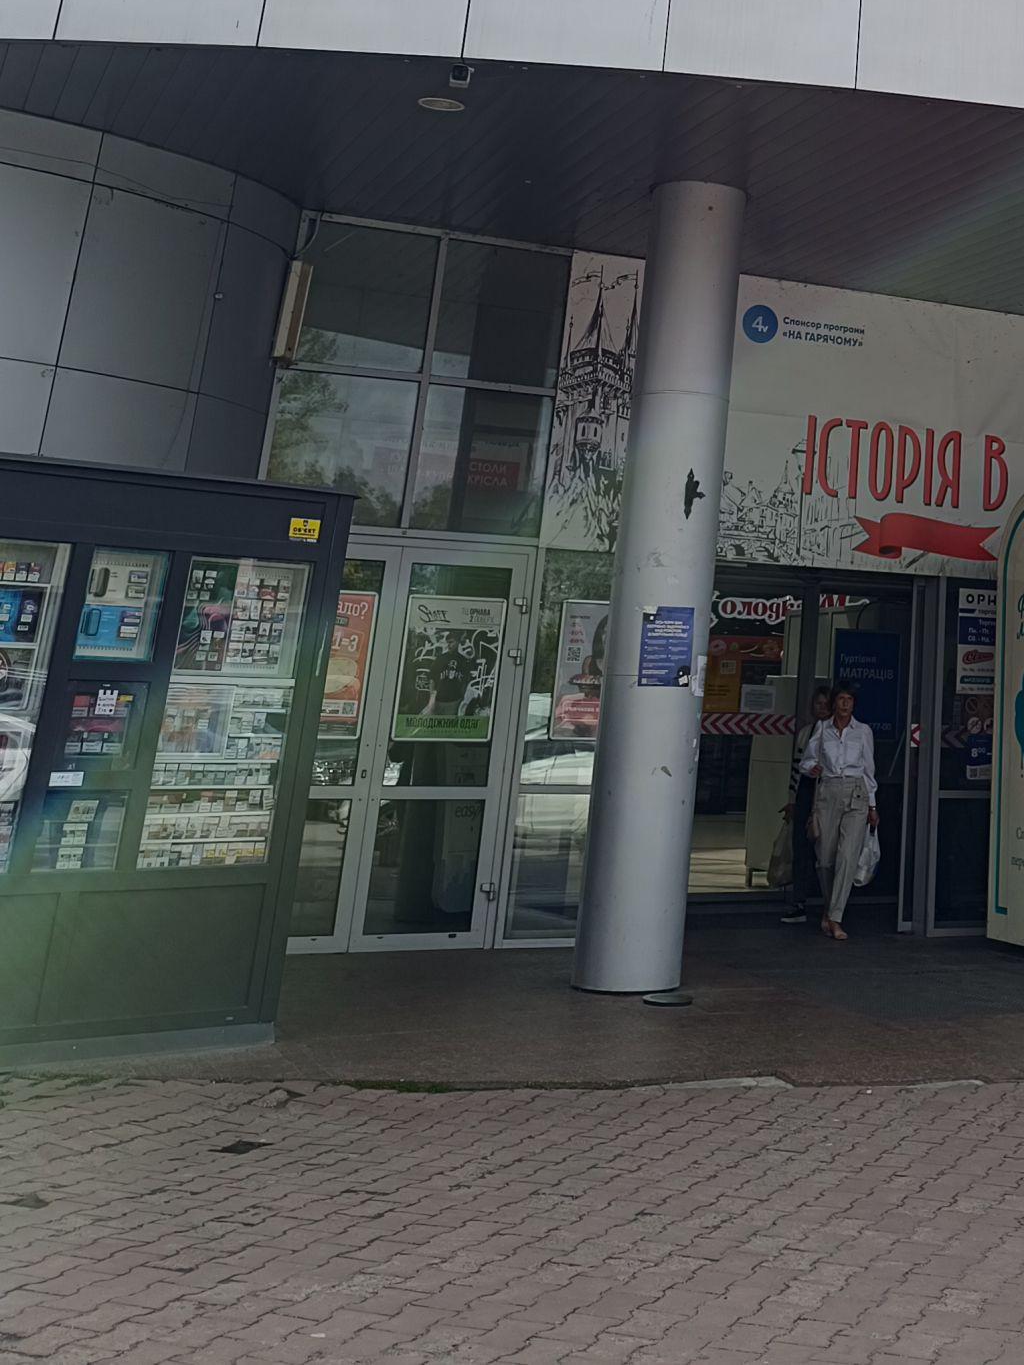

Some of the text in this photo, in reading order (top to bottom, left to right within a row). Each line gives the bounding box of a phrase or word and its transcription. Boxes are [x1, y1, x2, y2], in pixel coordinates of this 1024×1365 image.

[783, 316, 865, 335] Спонсор програми
[783, 330, 863, 347] «НА ГАРЯЧОМУ»
[468, 461, 507, 474] СТОЛИ
[803, 415, 962, 508] ІСТОРІЯ
[983, 434, 1008, 512] В
[466, 475, 508, 488] КРІСЛА
[839, 668, 895, 682] МАТРАЦІВ
